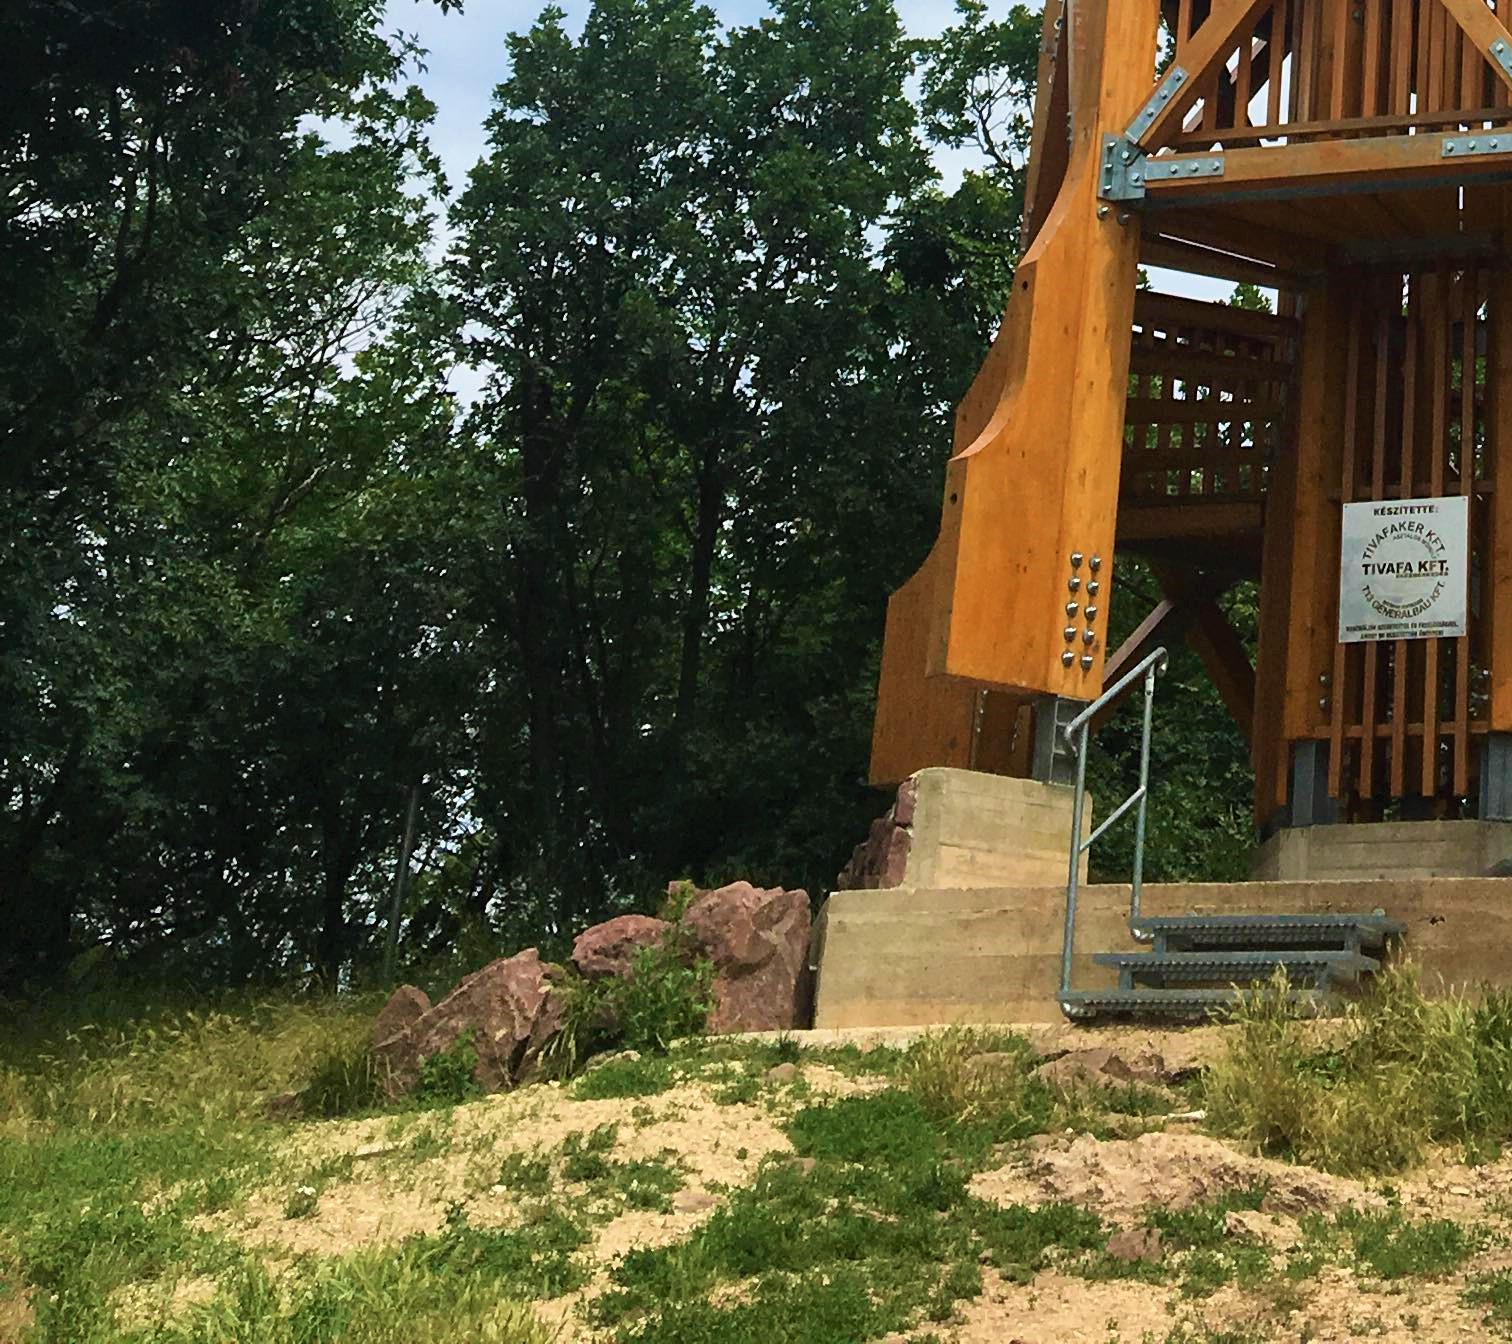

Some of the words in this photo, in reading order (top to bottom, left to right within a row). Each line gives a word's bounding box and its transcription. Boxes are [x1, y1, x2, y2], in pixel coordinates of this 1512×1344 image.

[1373, 505, 1439, 516] KÉSZÍTETTE:
[1362, 521, 1425, 560] TIVAFAKER
[1362, 562, 1413, 576] TIVAFA
[1418, 560, 1449, 573] KFT.
